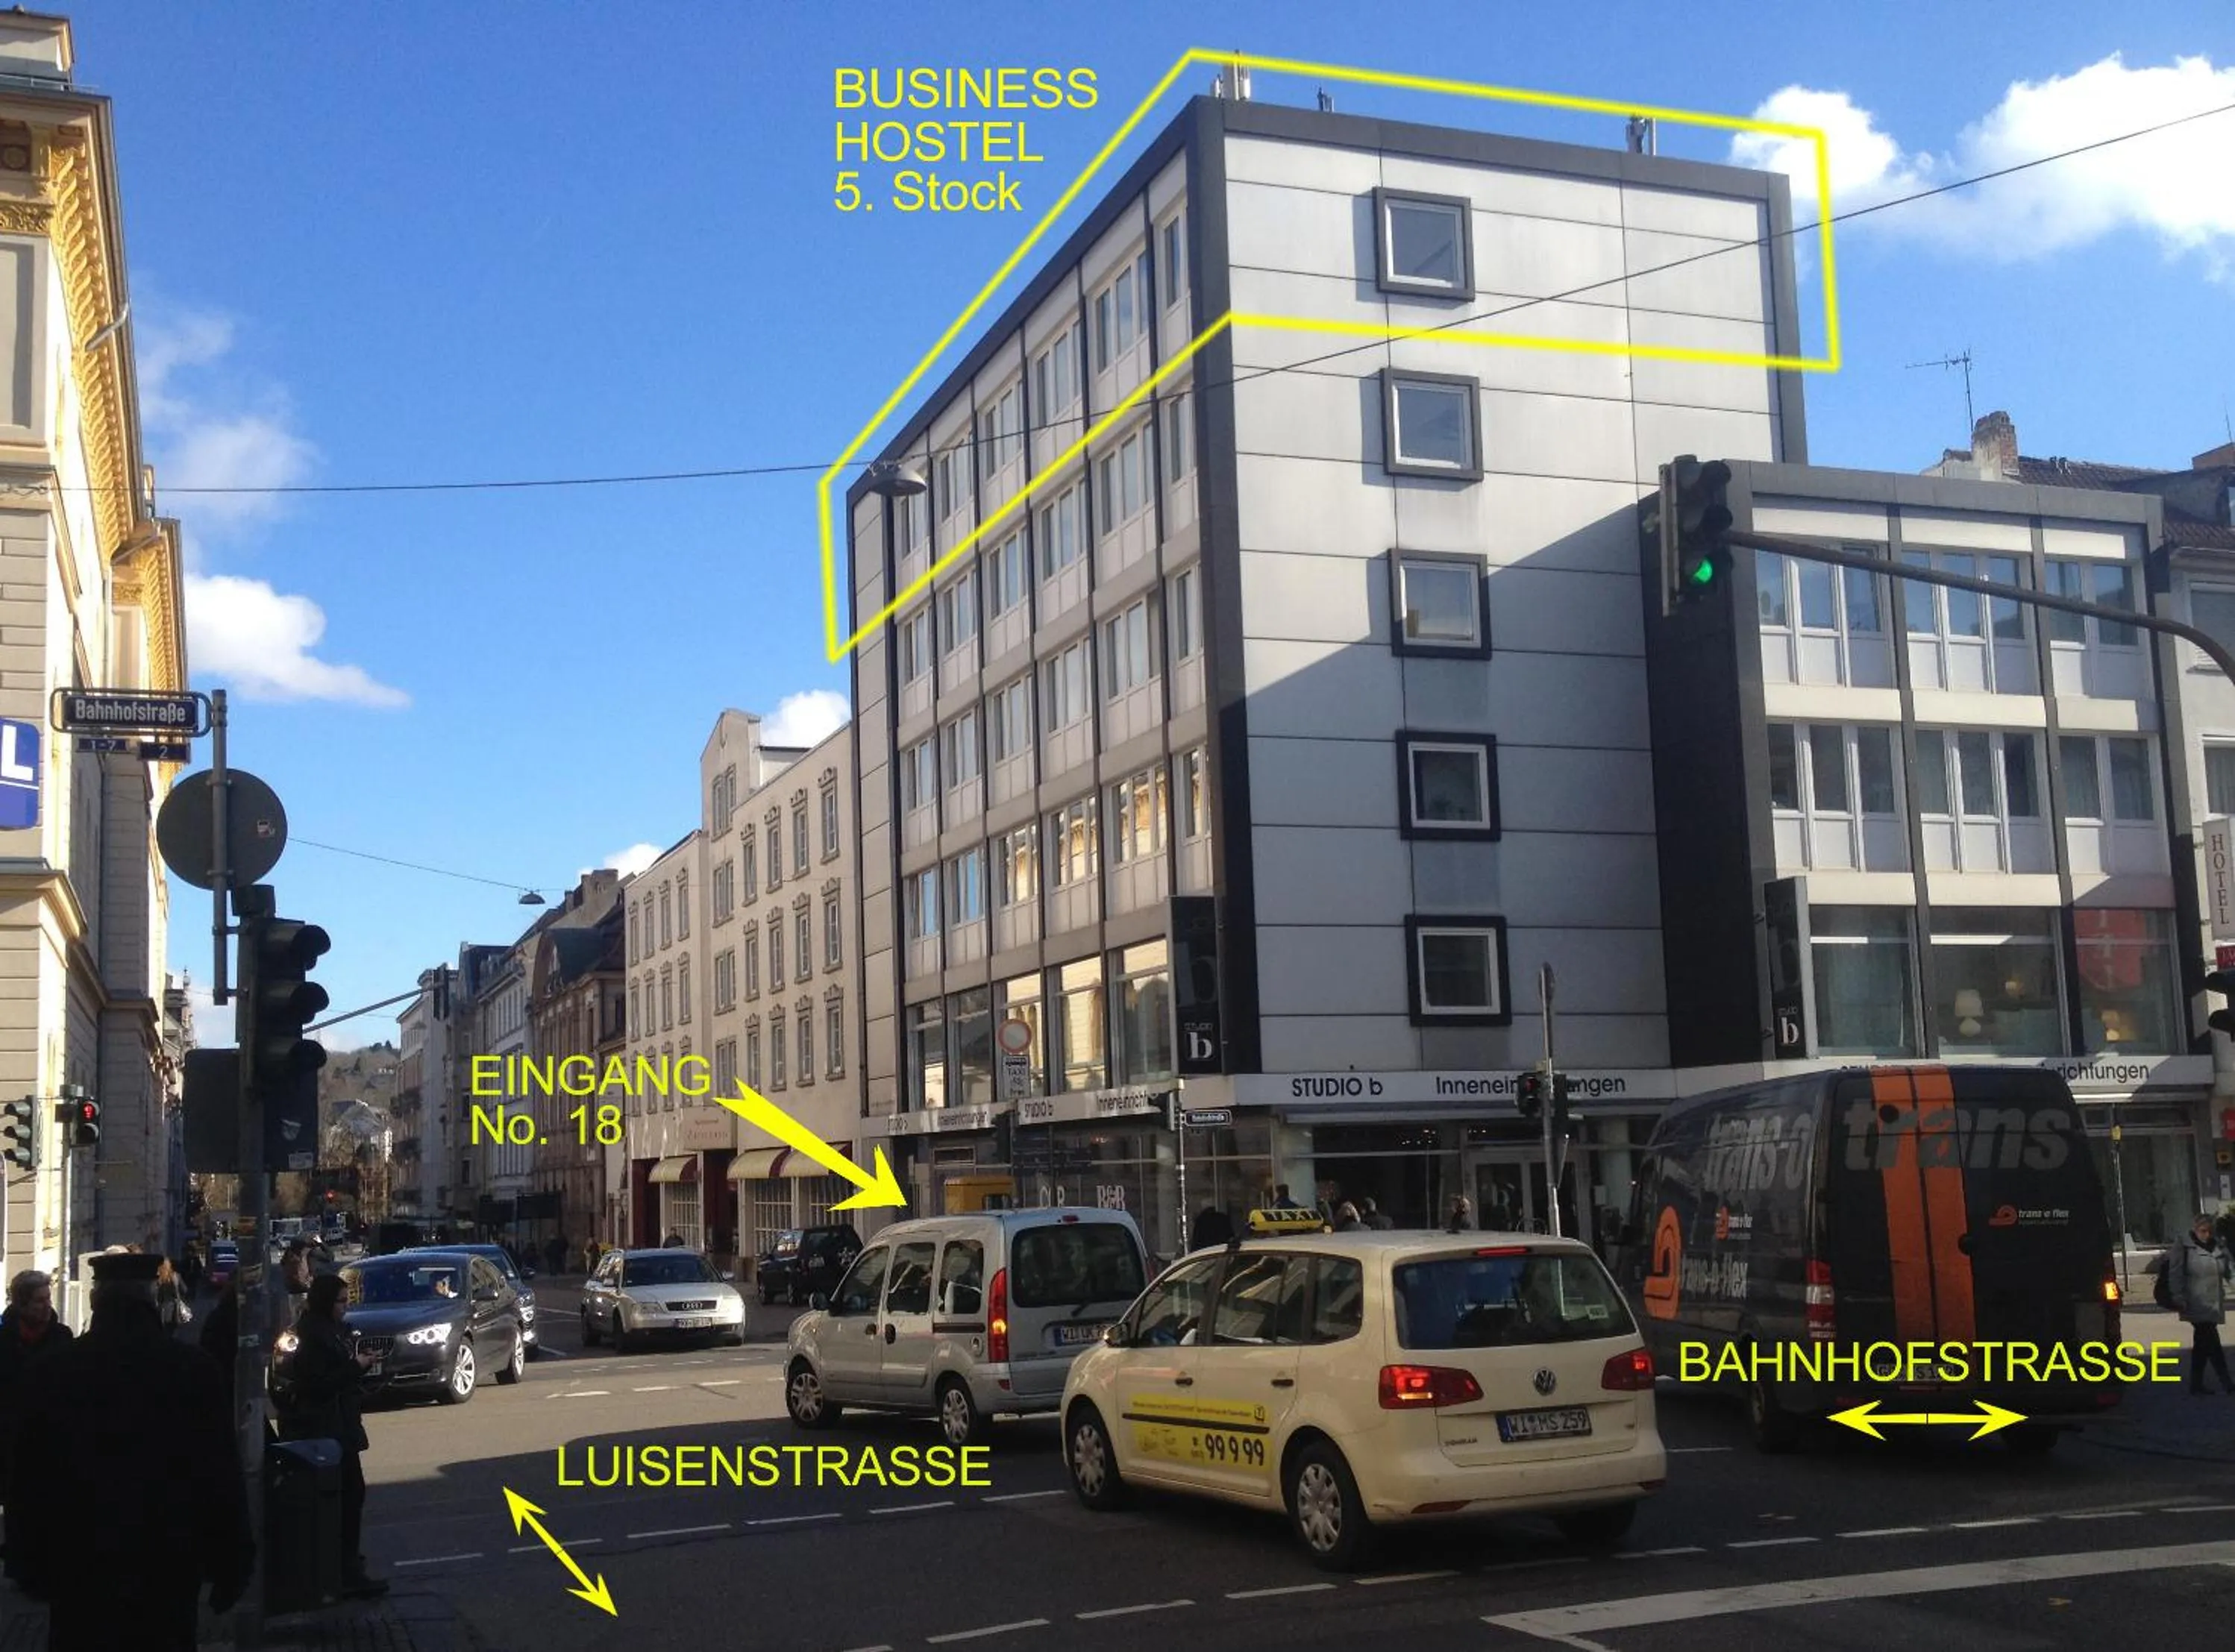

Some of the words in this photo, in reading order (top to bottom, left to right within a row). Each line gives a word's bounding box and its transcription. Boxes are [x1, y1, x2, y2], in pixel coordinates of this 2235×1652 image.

[75, 699, 186, 723] Bahnhofstraße
[159, 746, 169, 759] 2
[2210, 833, 2230, 925] HOTEL
[1780, 1017, 1800, 1045] b
[1188, 1031, 1213, 1060] b
[2039, 1060, 2150, 1084] richtungen
[1292, 1077, 1362, 1097] STUDIO
[1369, 1076, 1383, 1096] b
[1436, 1075, 1626, 1097] Inneneinngen
[1843, 1098, 2072, 1171] trans
[1262, 1209, 1314, 1221] TAXI
[1508, 1416, 1529, 1433] WI
[1537, 1413, 1558, 1431] MS
[1559, 1410, 1587, 1430] 259
[1205, 1433, 1226, 1460] 99
[1229, 1436, 1239, 1463] 9
[1242, 1437, 1264, 1466] 99
